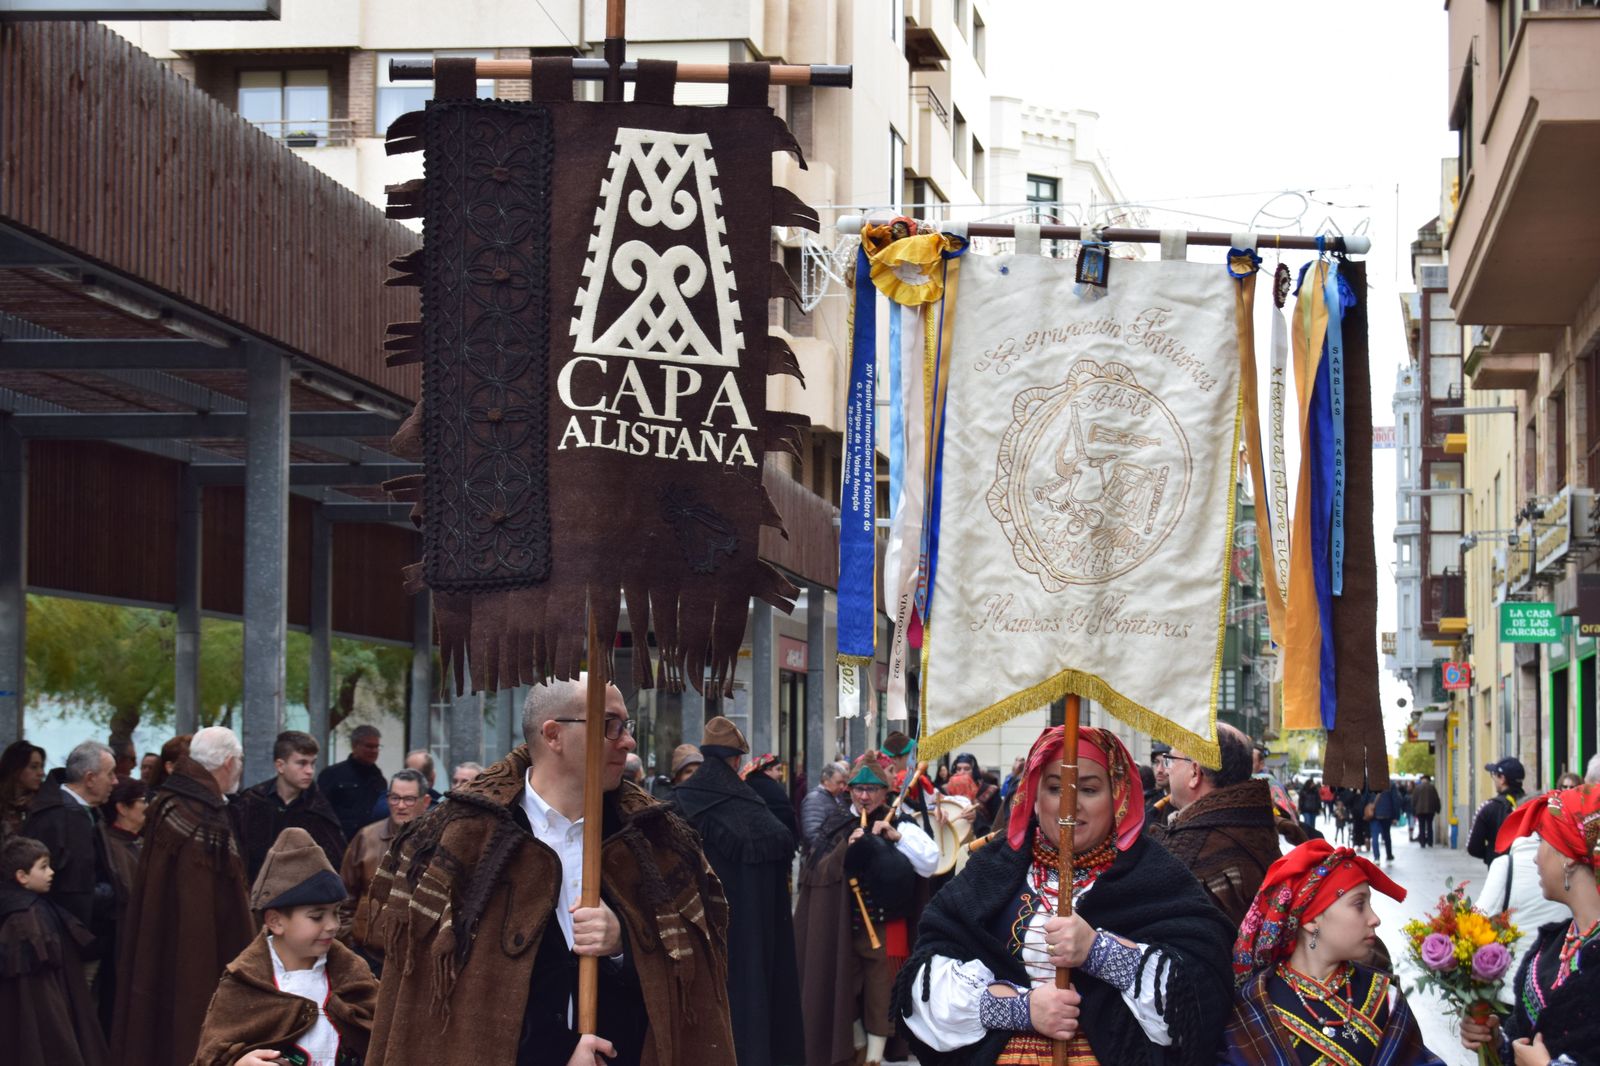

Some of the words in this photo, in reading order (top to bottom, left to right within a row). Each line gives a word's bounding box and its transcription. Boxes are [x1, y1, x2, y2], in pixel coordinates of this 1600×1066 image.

[865, 363, 873, 378] XIV
[557, 356, 758, 430] CAPA
[865, 380, 873, 411] Festival
[855, 400, 863, 432] Amigos
[557, 415, 758, 467] ALISTANA
[854, 432, 862, 444] de
[864, 413, 873, 469] Internacional
[853, 455, 862, 477] Vales
[1273, 445, 1285, 467] de
[864, 471, 872, 483] de
[851, 478, 861, 512] Monção
[864, 485, 873, 518] Folclore
[863, 520, 872, 532] do
[897, 593, 909, 644] VIMIOSO
[1509, 609, 1524, 618] LA
[1527, 609, 1552, 618] CASA
[1512, 619, 1526, 627] DE
[1530, 619, 1549, 627] LAS
[1505, 628, 1556, 637] CARCASAS
[893, 658, 901, 679] 2022
